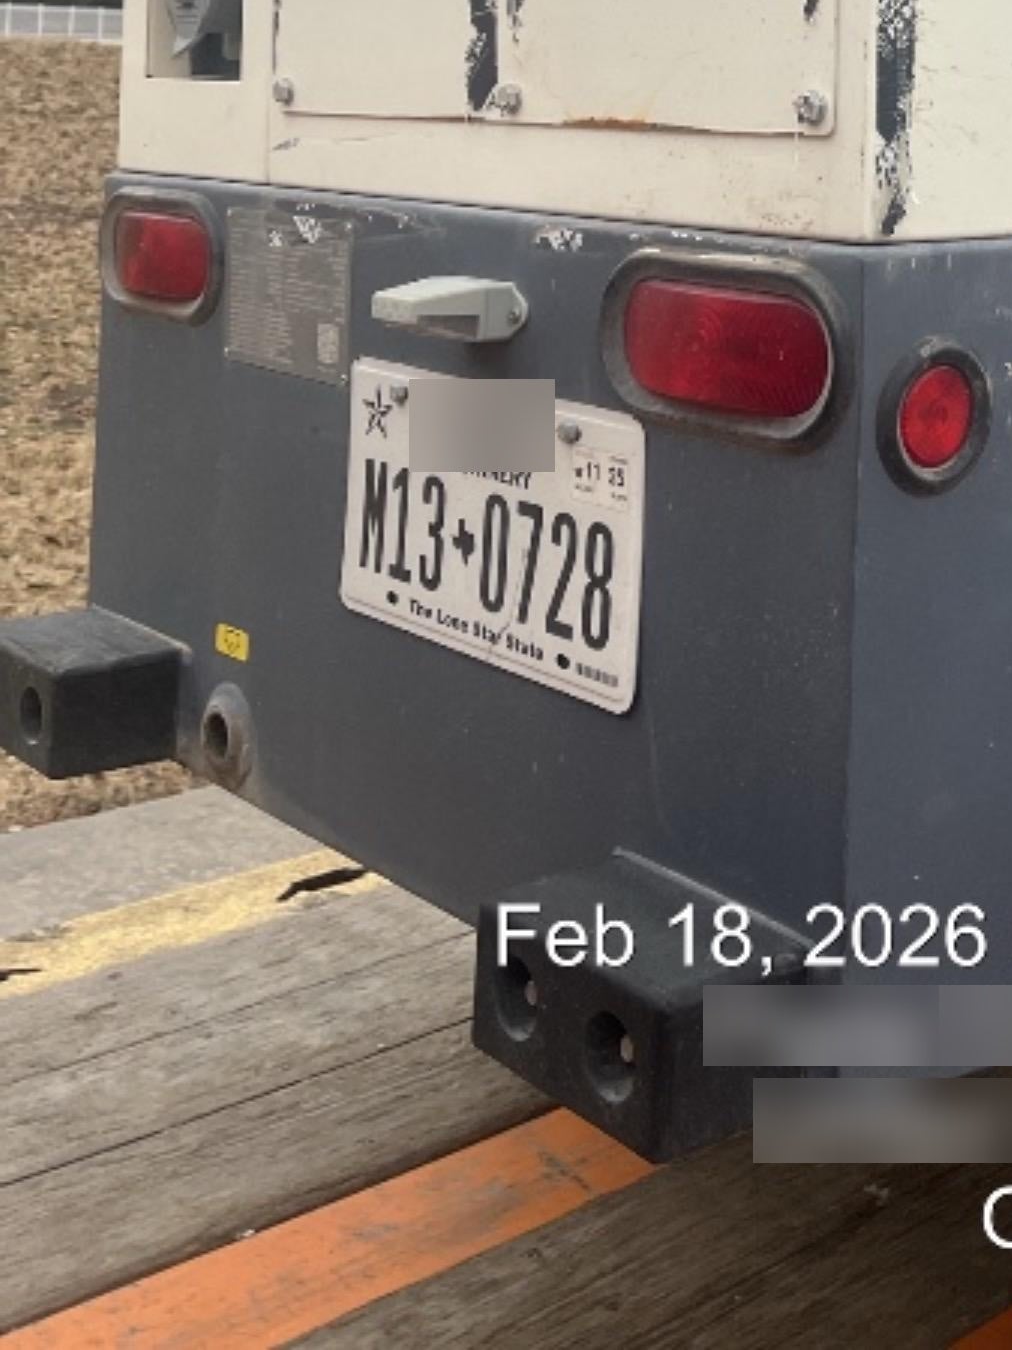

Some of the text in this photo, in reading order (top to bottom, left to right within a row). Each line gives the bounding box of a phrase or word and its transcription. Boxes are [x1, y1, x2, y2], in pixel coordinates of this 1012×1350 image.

[410, 599, 544, 661] The Lone Star State
